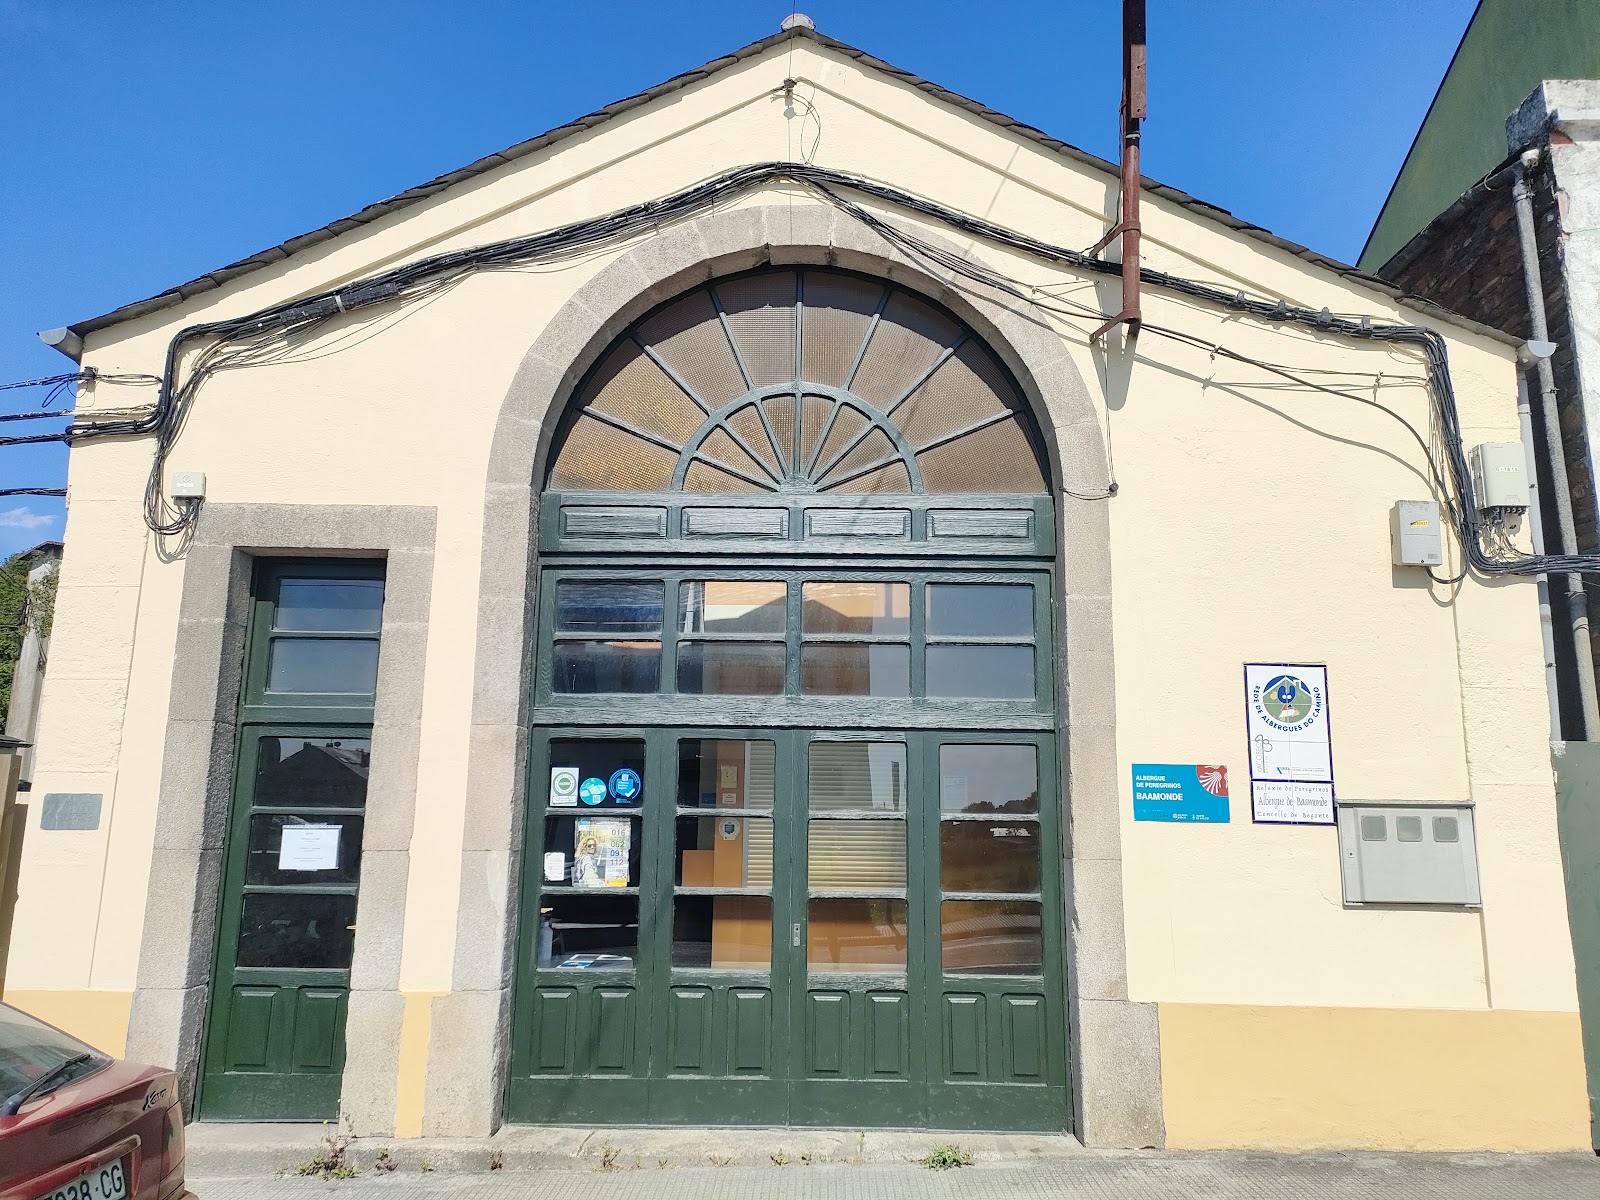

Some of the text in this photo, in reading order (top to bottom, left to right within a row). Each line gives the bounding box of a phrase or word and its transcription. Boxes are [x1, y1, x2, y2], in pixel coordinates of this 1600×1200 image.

[1255, 705, 1263, 714] DE
[1261, 715, 1303, 732] ALBERGUES
[1303, 718, 1314, 728] DO
[1312, 686, 1322, 718] CAMIÑO
[1256, 784, 1282, 792] Refuxio
[1136, 792, 1184, 801] BAAMONDE
[1258, 793, 1328, 809] Albergue de Baamonde
[1257, 810, 1287, 818] Concello
